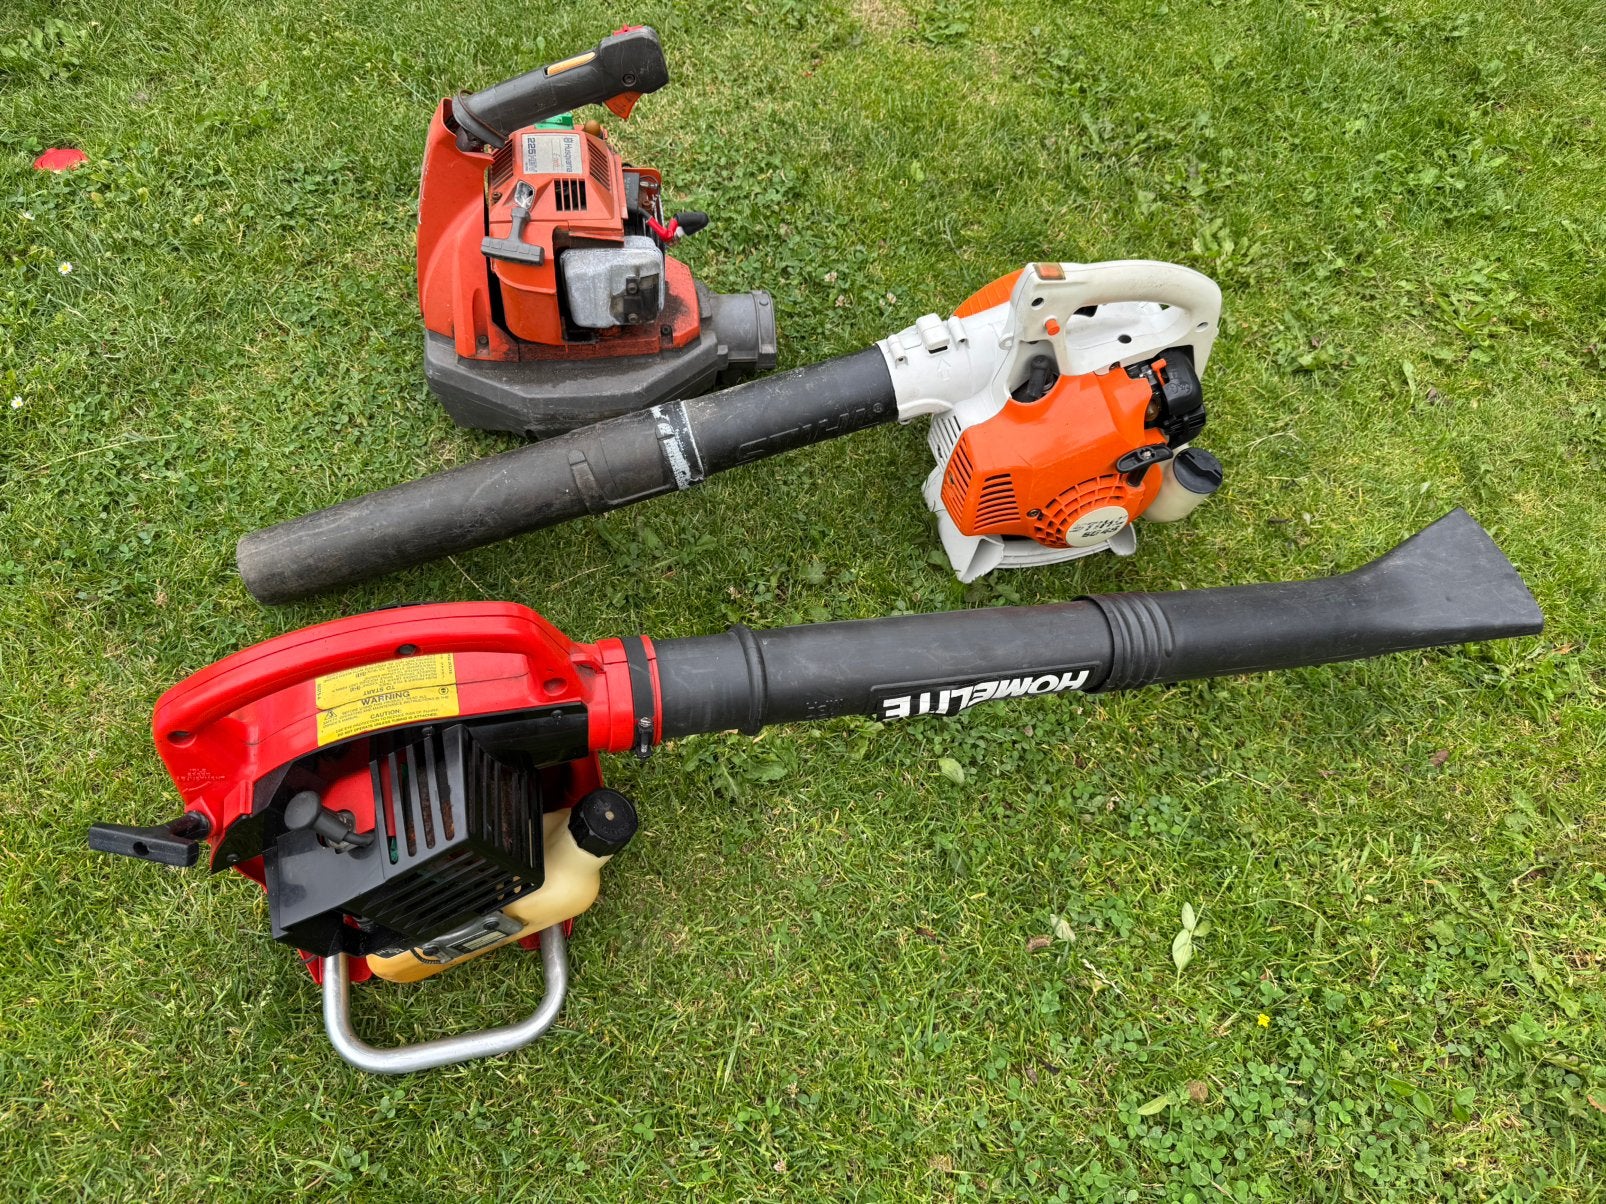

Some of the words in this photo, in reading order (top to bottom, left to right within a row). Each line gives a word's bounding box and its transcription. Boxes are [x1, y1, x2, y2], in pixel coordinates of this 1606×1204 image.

[564, 144, 573, 173] Husqvarna
[361, 690, 410, 706] WARNING
[363, 687, 384, 696] START
[882, 670, 1090, 722] HOMELITE
